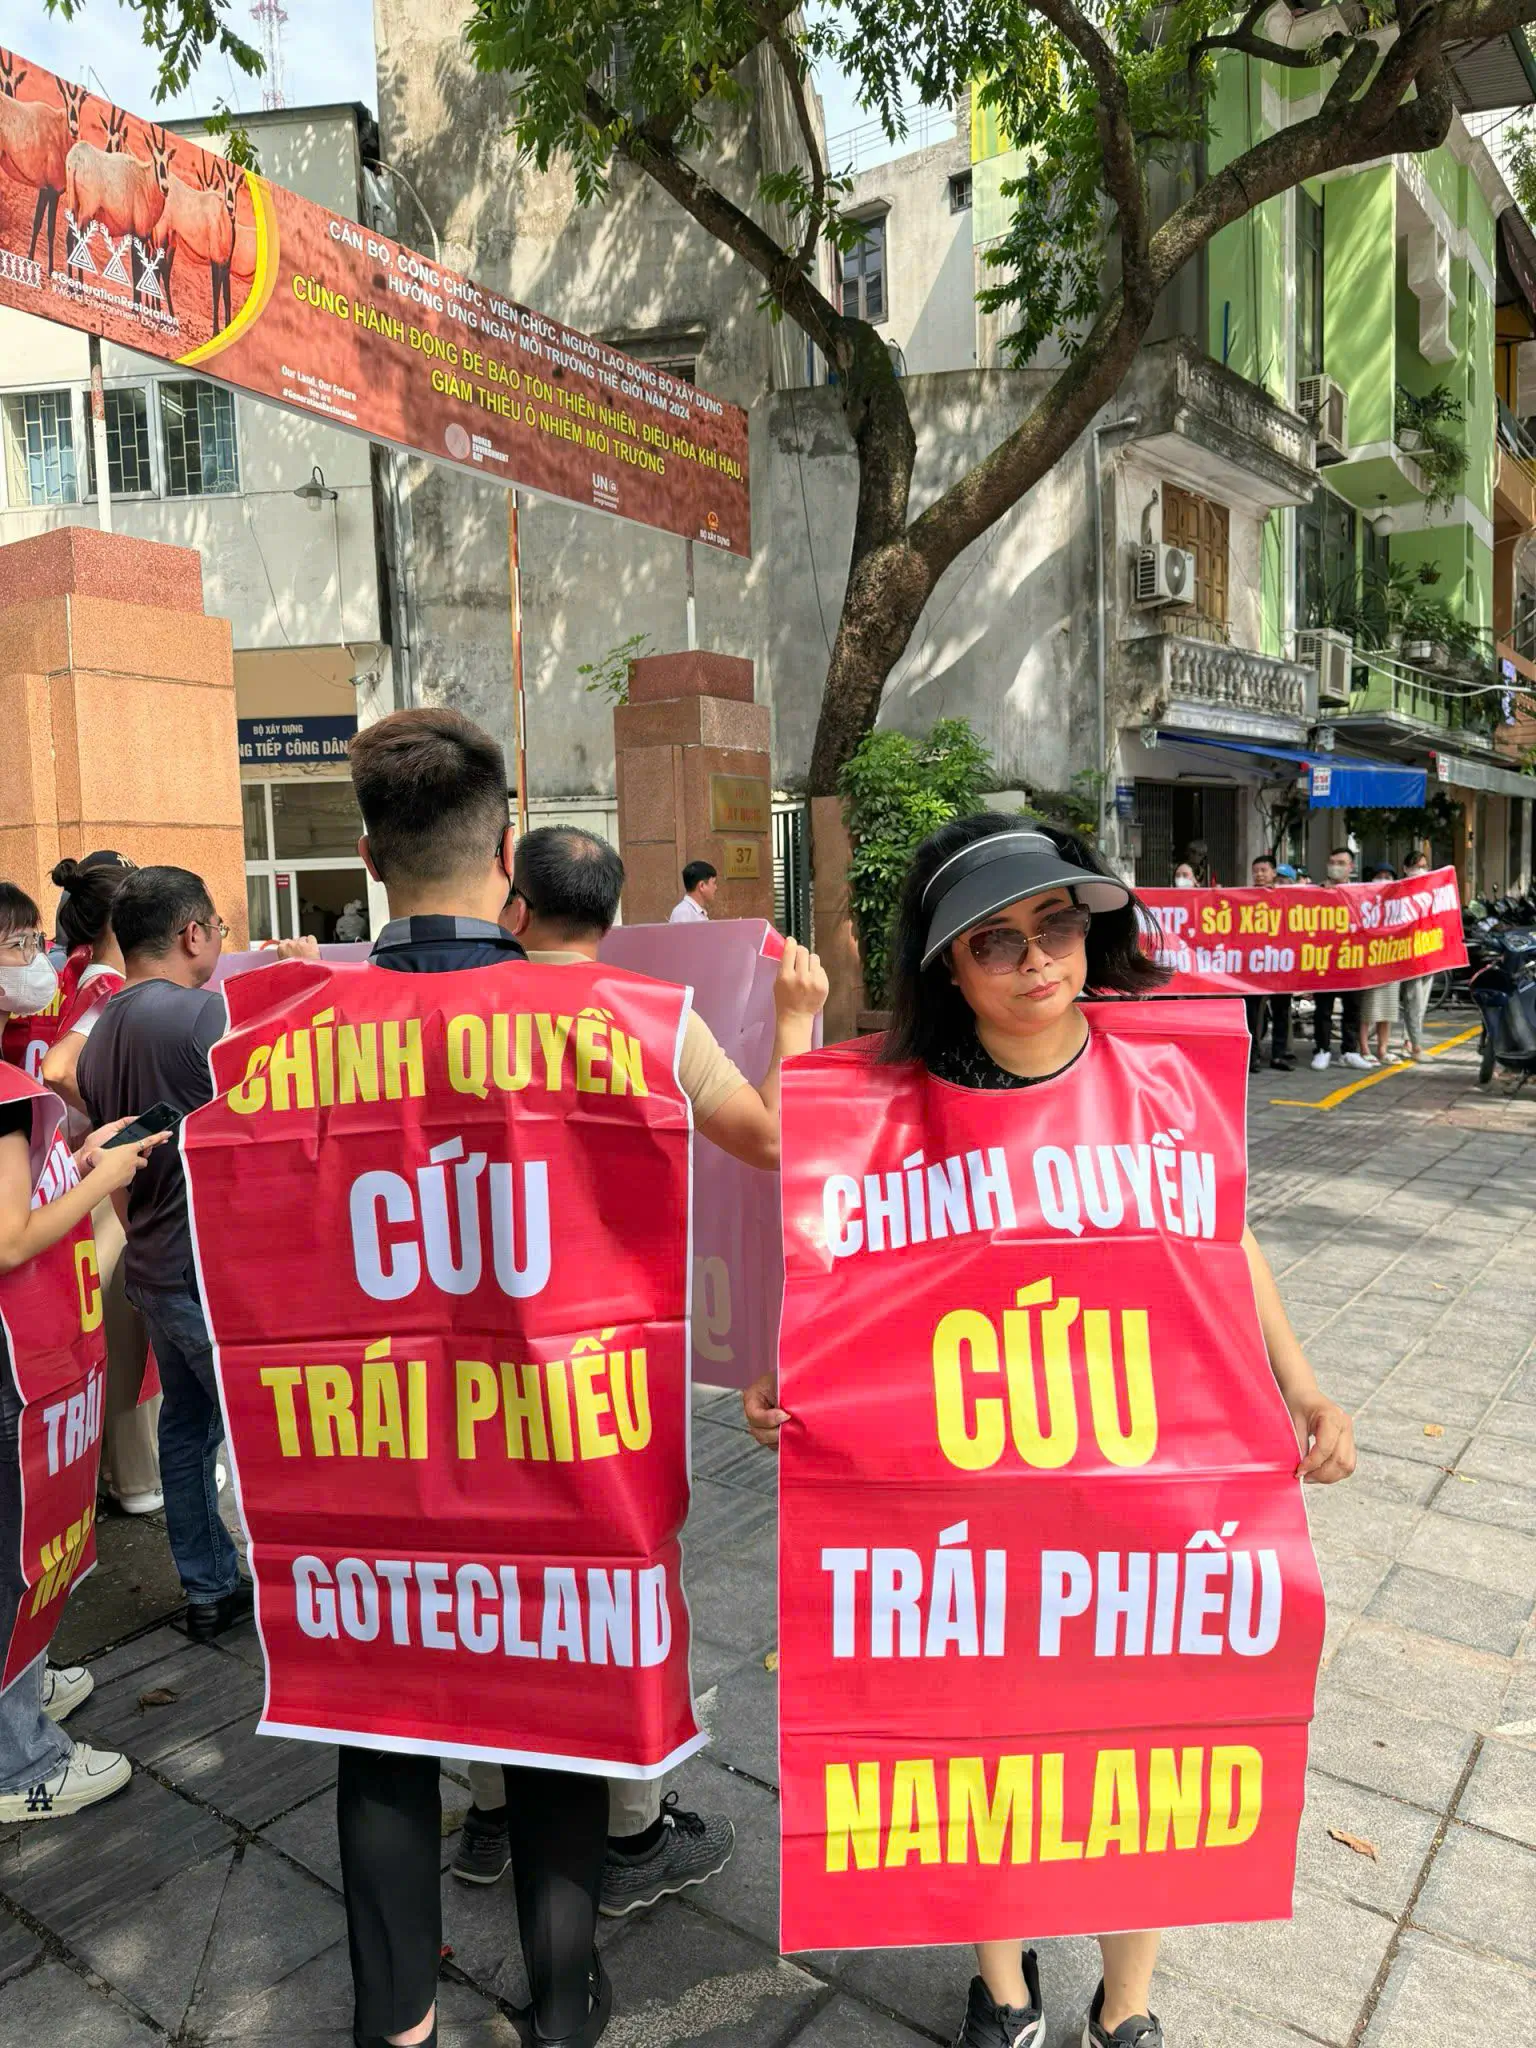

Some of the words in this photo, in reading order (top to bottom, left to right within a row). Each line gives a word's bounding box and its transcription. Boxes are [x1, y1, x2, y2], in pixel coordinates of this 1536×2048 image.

[51, 270, 179, 327] #GenerationRestoration
[368, 240, 394, 268] BỘ,
[398, 254, 440, 287] CÔNG
[443, 277, 486, 312] CHỨC,
[489, 298, 518, 324] VIÊN
[521, 314, 559, 345] CHỨC,
[562, 332, 600, 361] NGƯỜI
[602, 351, 624, 372] LAO
[626, 362, 656, 386] ĐỘNG
[659, 376, 673, 396] BỘ
[675, 381, 694, 402] XÂY
[696, 395, 723, 416] DỰNG
[388, 274, 443, 312] HƯỞNG
[447, 300, 478, 328] ỨNG
[481, 317, 516, 344] NGÀY
[520, 334, 542, 357] MÔI
[545, 346, 595, 379] TRƯỜNG
[598, 368, 618, 390] THẾ
[621, 378, 644, 400] GIỚI
[645, 390, 668, 410] NĂM
[670, 402, 690, 420] 2024
[292, 275, 350, 320] CÙNG
[354, 301, 405, 344] HÀNH
[408, 328, 458, 366] ĐỘNG
[488, 360, 521, 390] BẢO
[556, 387, 596, 421] THIÊN
[599, 405, 640, 441] NHIÊN,
[642, 423, 670, 450] ĐIỀU
[672, 436, 697, 462] HÒA
[699, 447, 717, 469] KHÍ
[719, 456, 744, 484] HẬU,
[432, 369, 472, 404] GIẢM
[476, 386, 521, 421] THIỂU
[525, 402, 536, 427] Ô
[540, 411, 582, 444] NHIỄM
[586, 428, 610, 455] MÔI
[612, 439, 666, 476] TRƯỜNG
[592, 472, 608, 492] UN
[252, 724, 264, 736] BỘ
[282, 724, 304, 736] DỰNG
[255, 737, 282, 756] TIẾP
[286, 739, 320, 756] CÔNG
[322, 737, 349, 754] DÂN
[736, 848, 752, 864] 37
[1196, 944, 1242, 974] bán
[1250, 944, 1295, 973] cho
[1301, 943, 1334, 976] Dự
[1337, 940, 1364, 970] án
[1368, 936, 1412, 967] Shizen
[1202, 900, 1232, 934] Sở
[1239, 902, 1282, 937] Xây
[1361, 894, 1382, 928] Sở
[227, 1006, 426, 1114] CHÍNH
[446, 1007, 648, 1100] QUYỀN
[349, 1135, 552, 1301] CỨU
[822, 1149, 1017, 1258] CHÍNH
[1032, 1128, 1216, 1238] QUYỀN
[44, 1361, 103, 1476] TRÁI
[260, 1336, 428, 1460] TRÁI
[454, 1327, 653, 1463] PHIẾU
[932, 1276, 1158, 1471] CỨU
[291, 1554, 672, 1669] GOTECLAND
[820, 1520, 1007, 1658] TRÁI
[1038, 1520, 1282, 1658] PHIẾU
[825, 1744, 1264, 1873] NAMLAND
